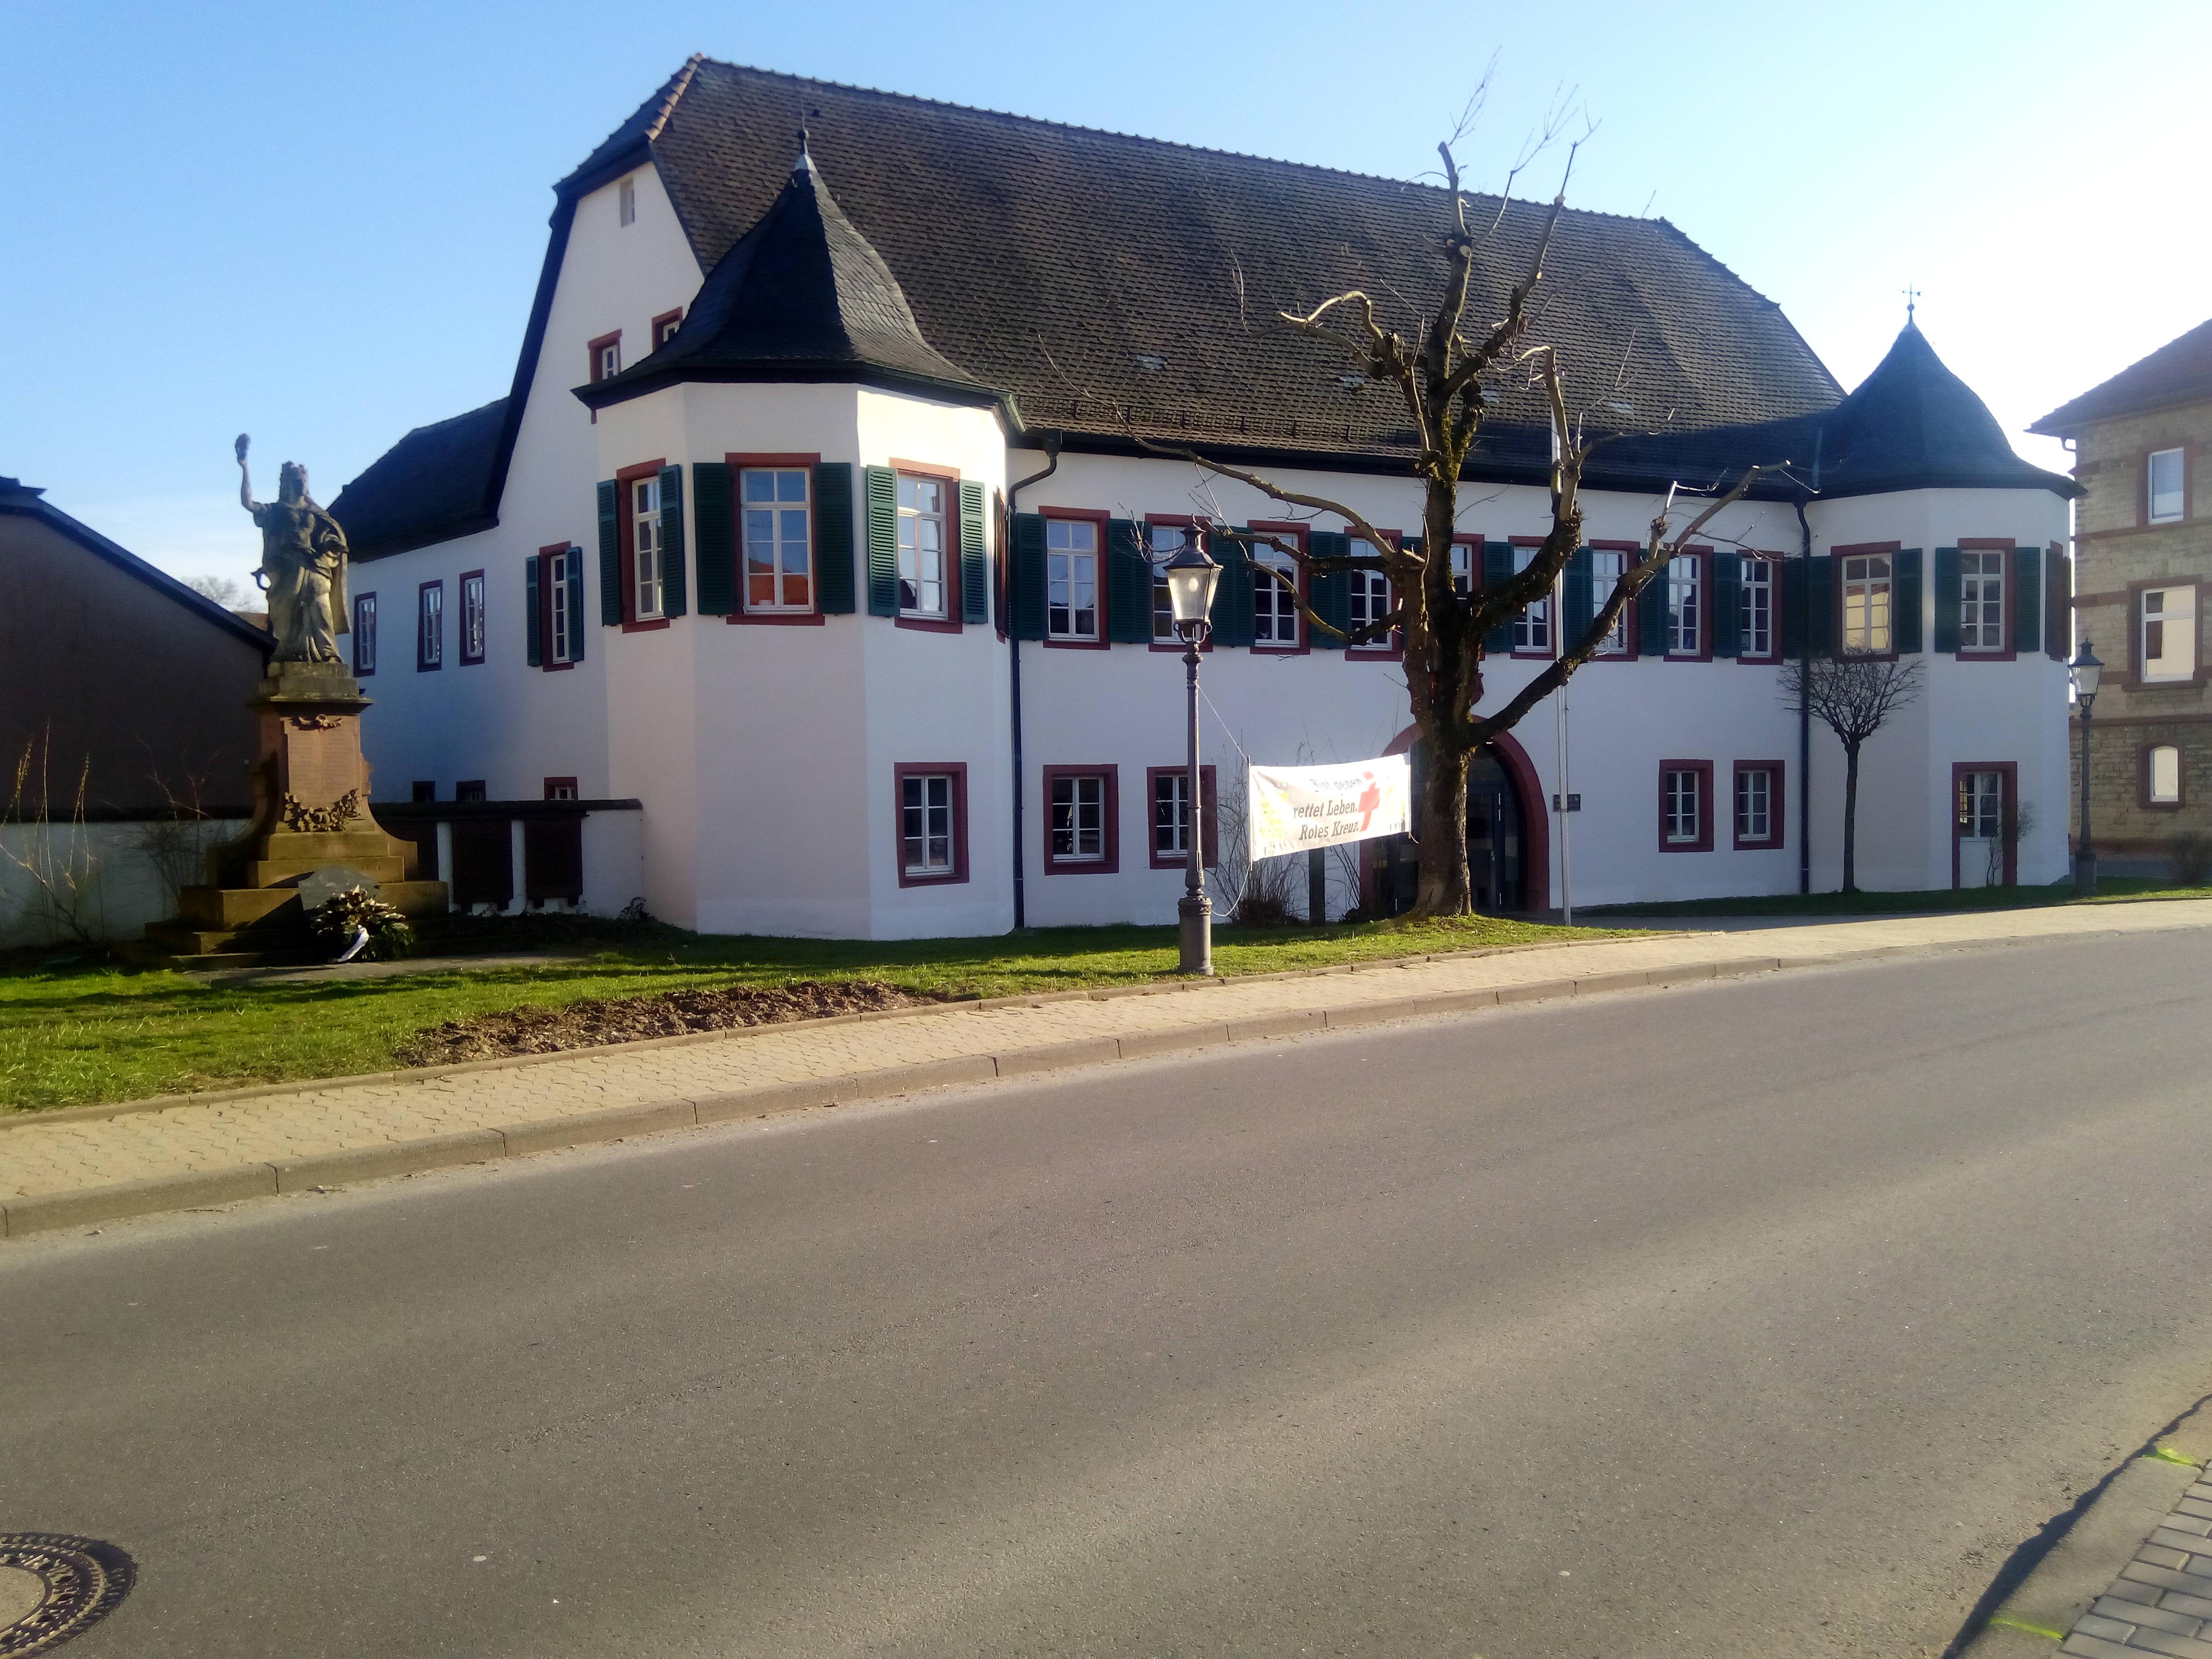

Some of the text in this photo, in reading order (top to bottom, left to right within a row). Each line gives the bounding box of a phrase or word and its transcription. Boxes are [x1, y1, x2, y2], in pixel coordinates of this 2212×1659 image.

[1293, 800, 1357, 818] rettet Leben.
[1298, 821, 1359, 840] Rotes Kreuz.
